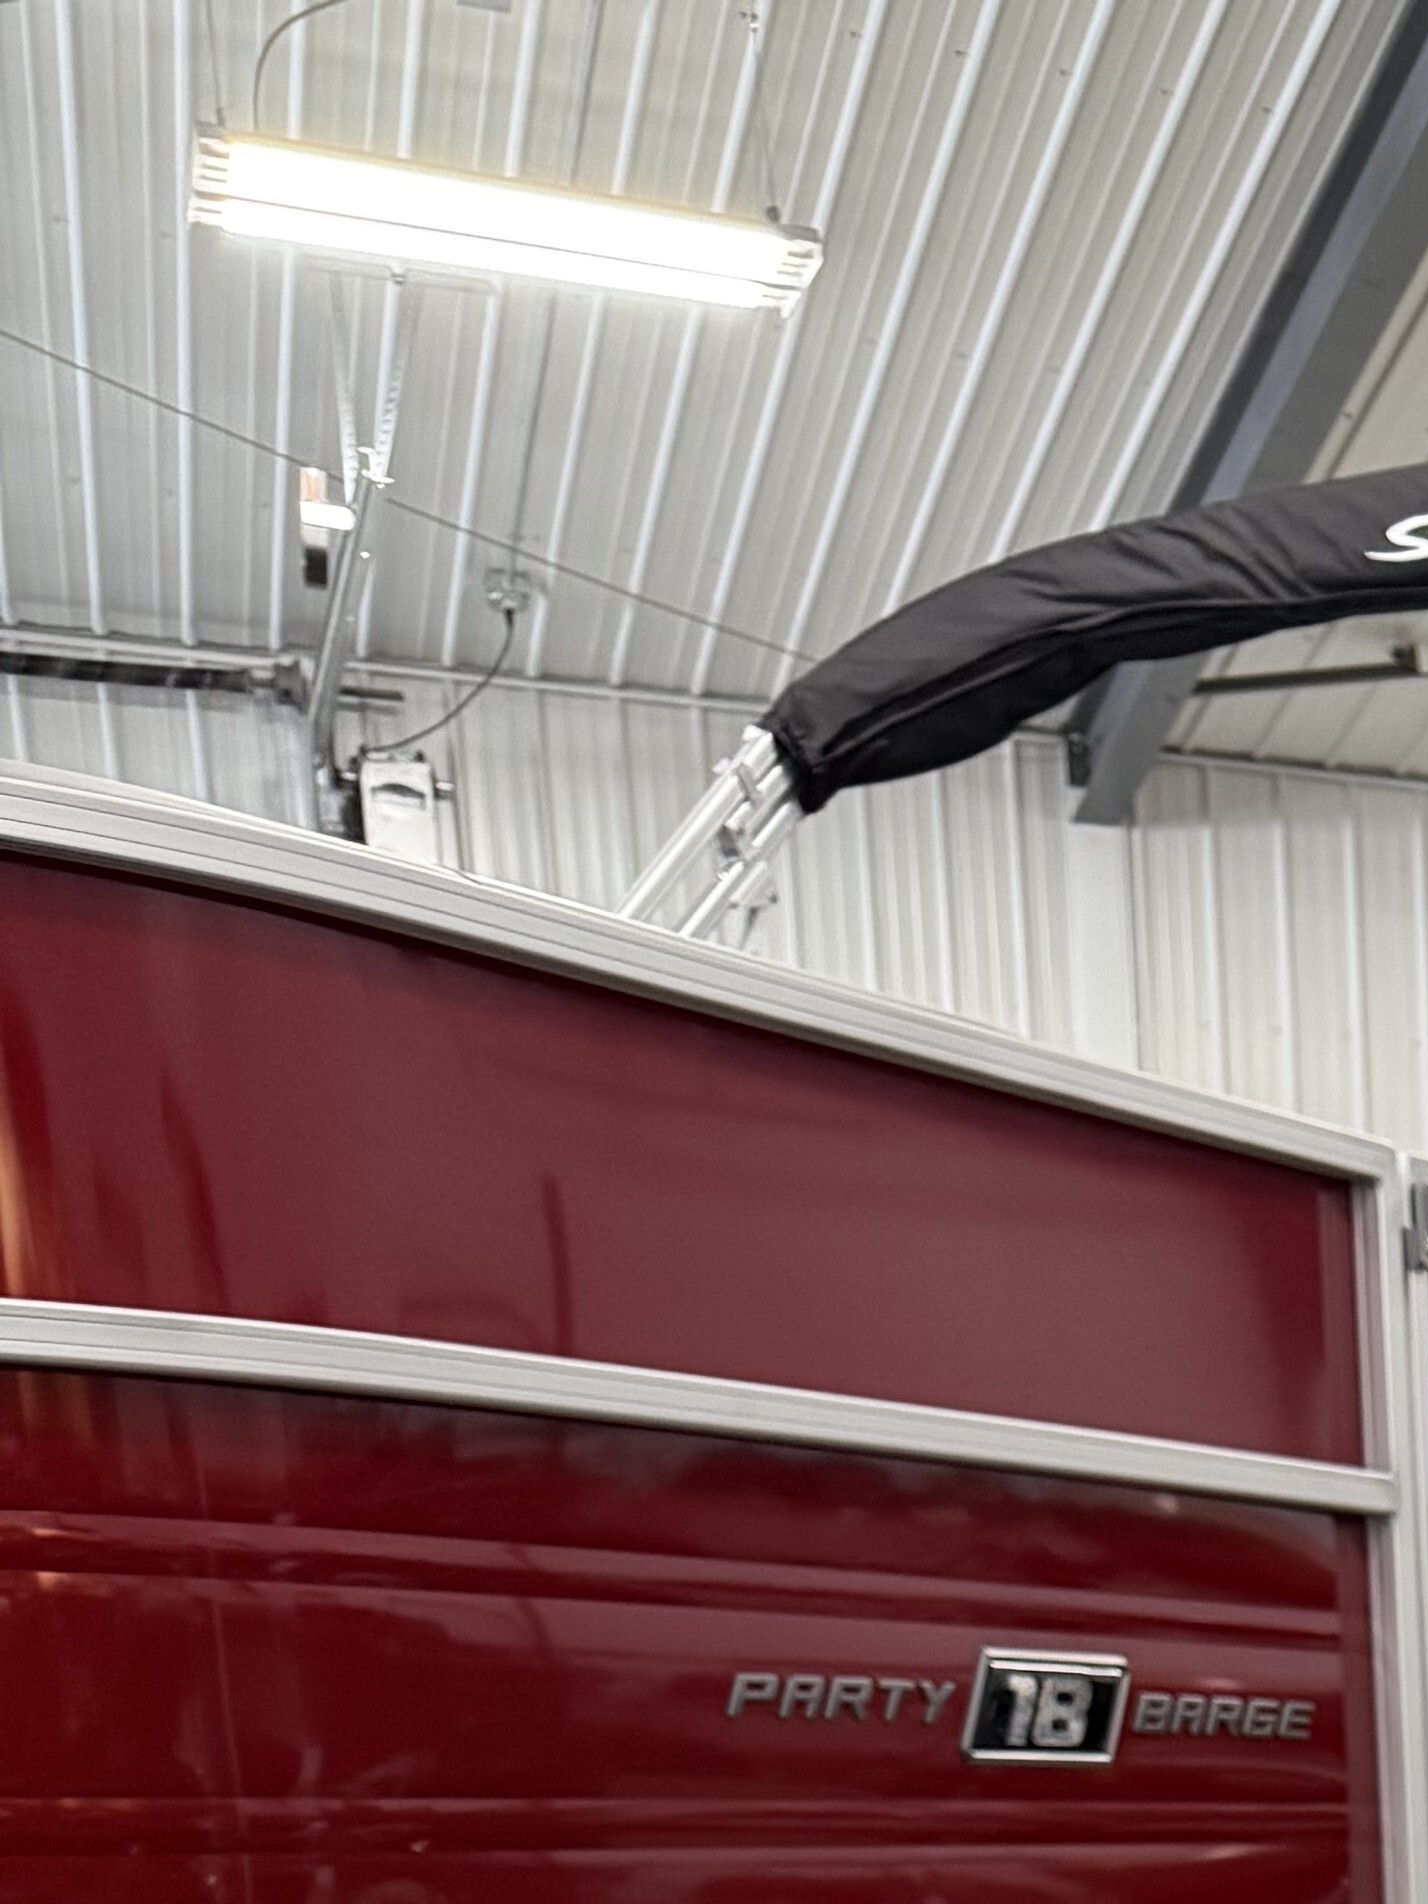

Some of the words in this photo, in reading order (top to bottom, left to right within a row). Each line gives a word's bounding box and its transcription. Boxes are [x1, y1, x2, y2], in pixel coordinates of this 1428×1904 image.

[726, 1672, 956, 1724] PARTY
[1003, 1674, 1094, 1748] 18
[1132, 1691, 1316, 1738] BARGE
